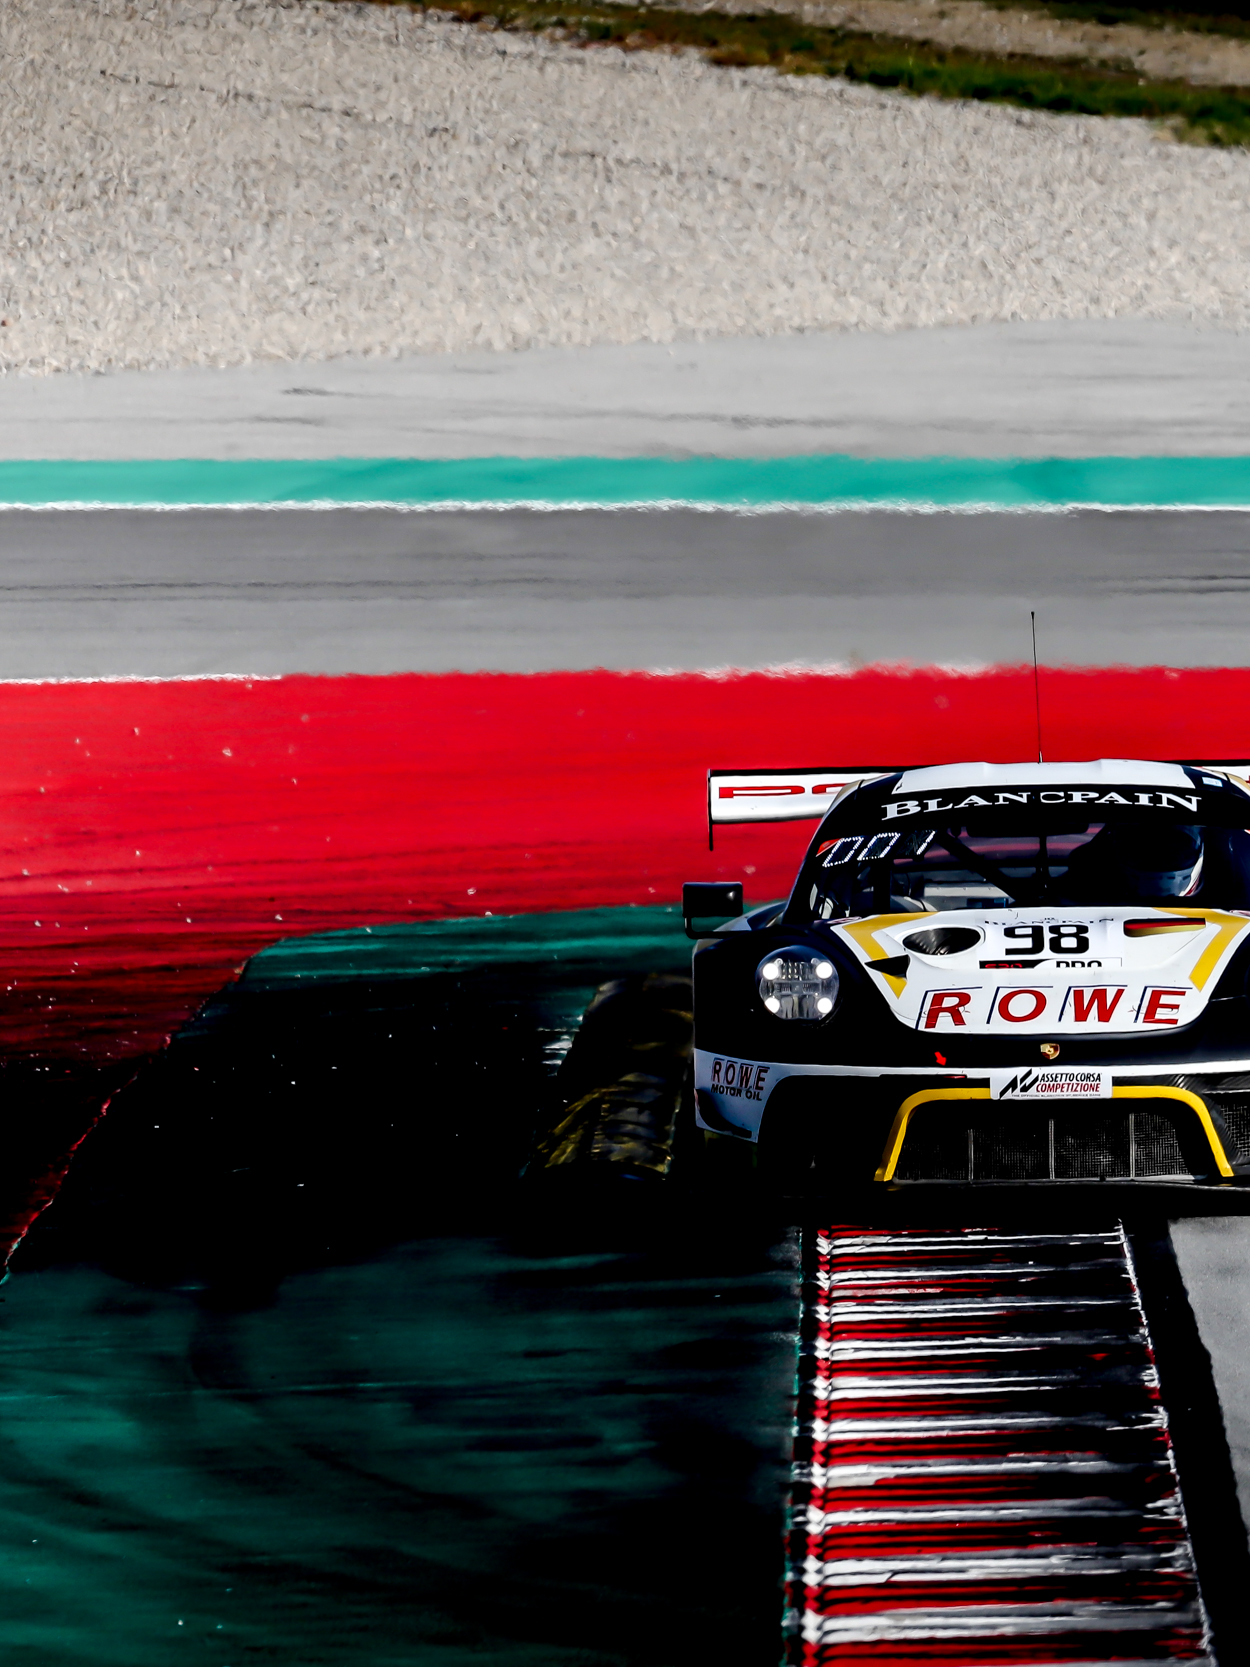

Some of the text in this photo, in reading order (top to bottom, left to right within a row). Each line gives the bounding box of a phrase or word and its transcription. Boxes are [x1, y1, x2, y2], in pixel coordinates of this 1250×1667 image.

[881, 791, 1202, 820] BLANCPAIN
[1003, 925, 1089, 955] 98
[924, 987, 1187, 1030] ROWE
[712, 1060, 769, 1091] ROWE
[1036, 1082, 1101, 1093] COMPETIZIONE
[1040, 1072, 1101, 1082] ASSETTO CORSA
[711, 1084, 763, 1102] MOTOR OIL
